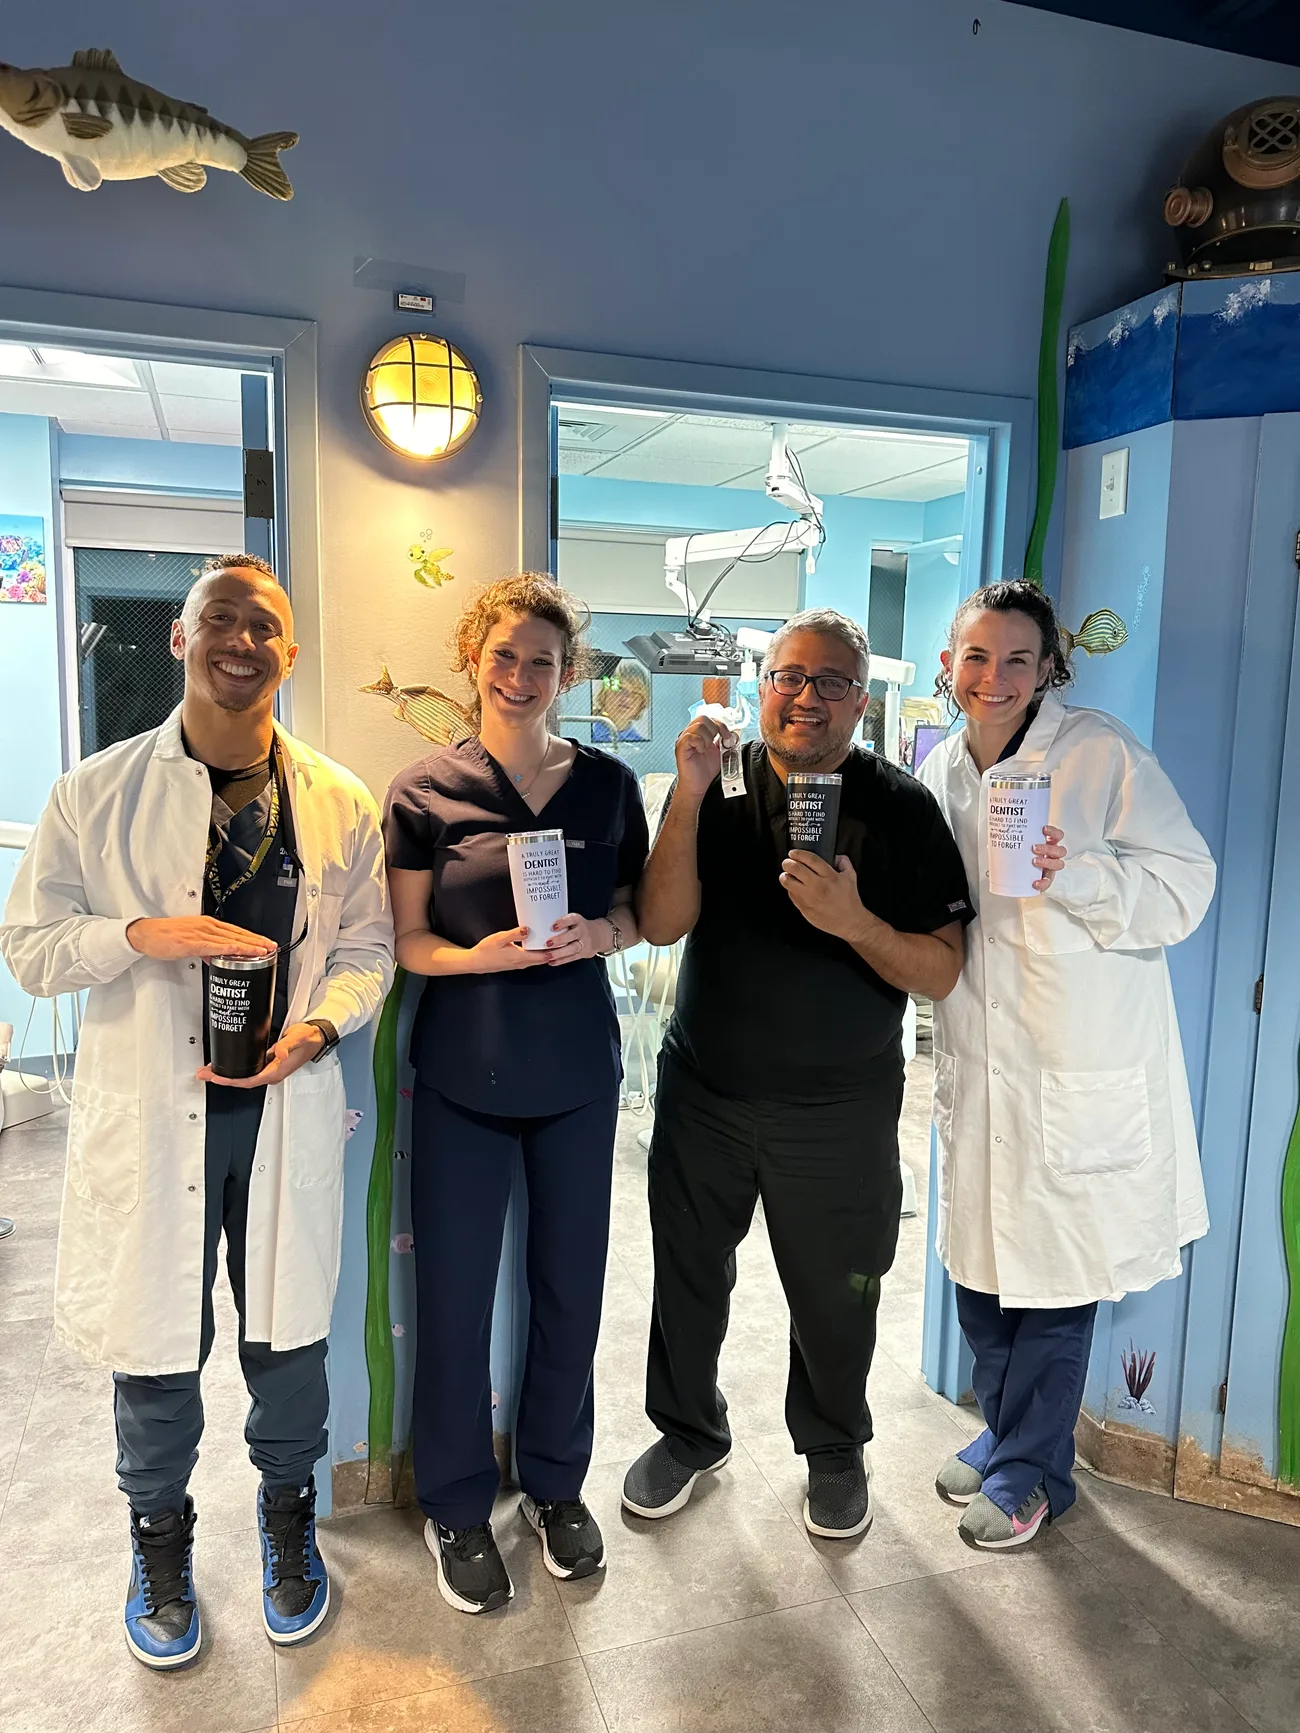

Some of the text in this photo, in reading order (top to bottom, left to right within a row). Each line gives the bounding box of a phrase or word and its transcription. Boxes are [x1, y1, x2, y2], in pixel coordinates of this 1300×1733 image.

[790, 801, 823, 810] DENTIST
[991, 805, 1024, 816] DENTIST
[525, 858, 558, 869] DENTIST
[527, 884, 561, 894] IMPOSSIBLE
[540, 892, 560, 900] FORGET
[213, 976, 228, 984] TRULY
[229, 980, 250, 988] GREAT
[211, 984, 247, 998] DENTIST
[212, 1019, 243, 1032] TO FORGET
